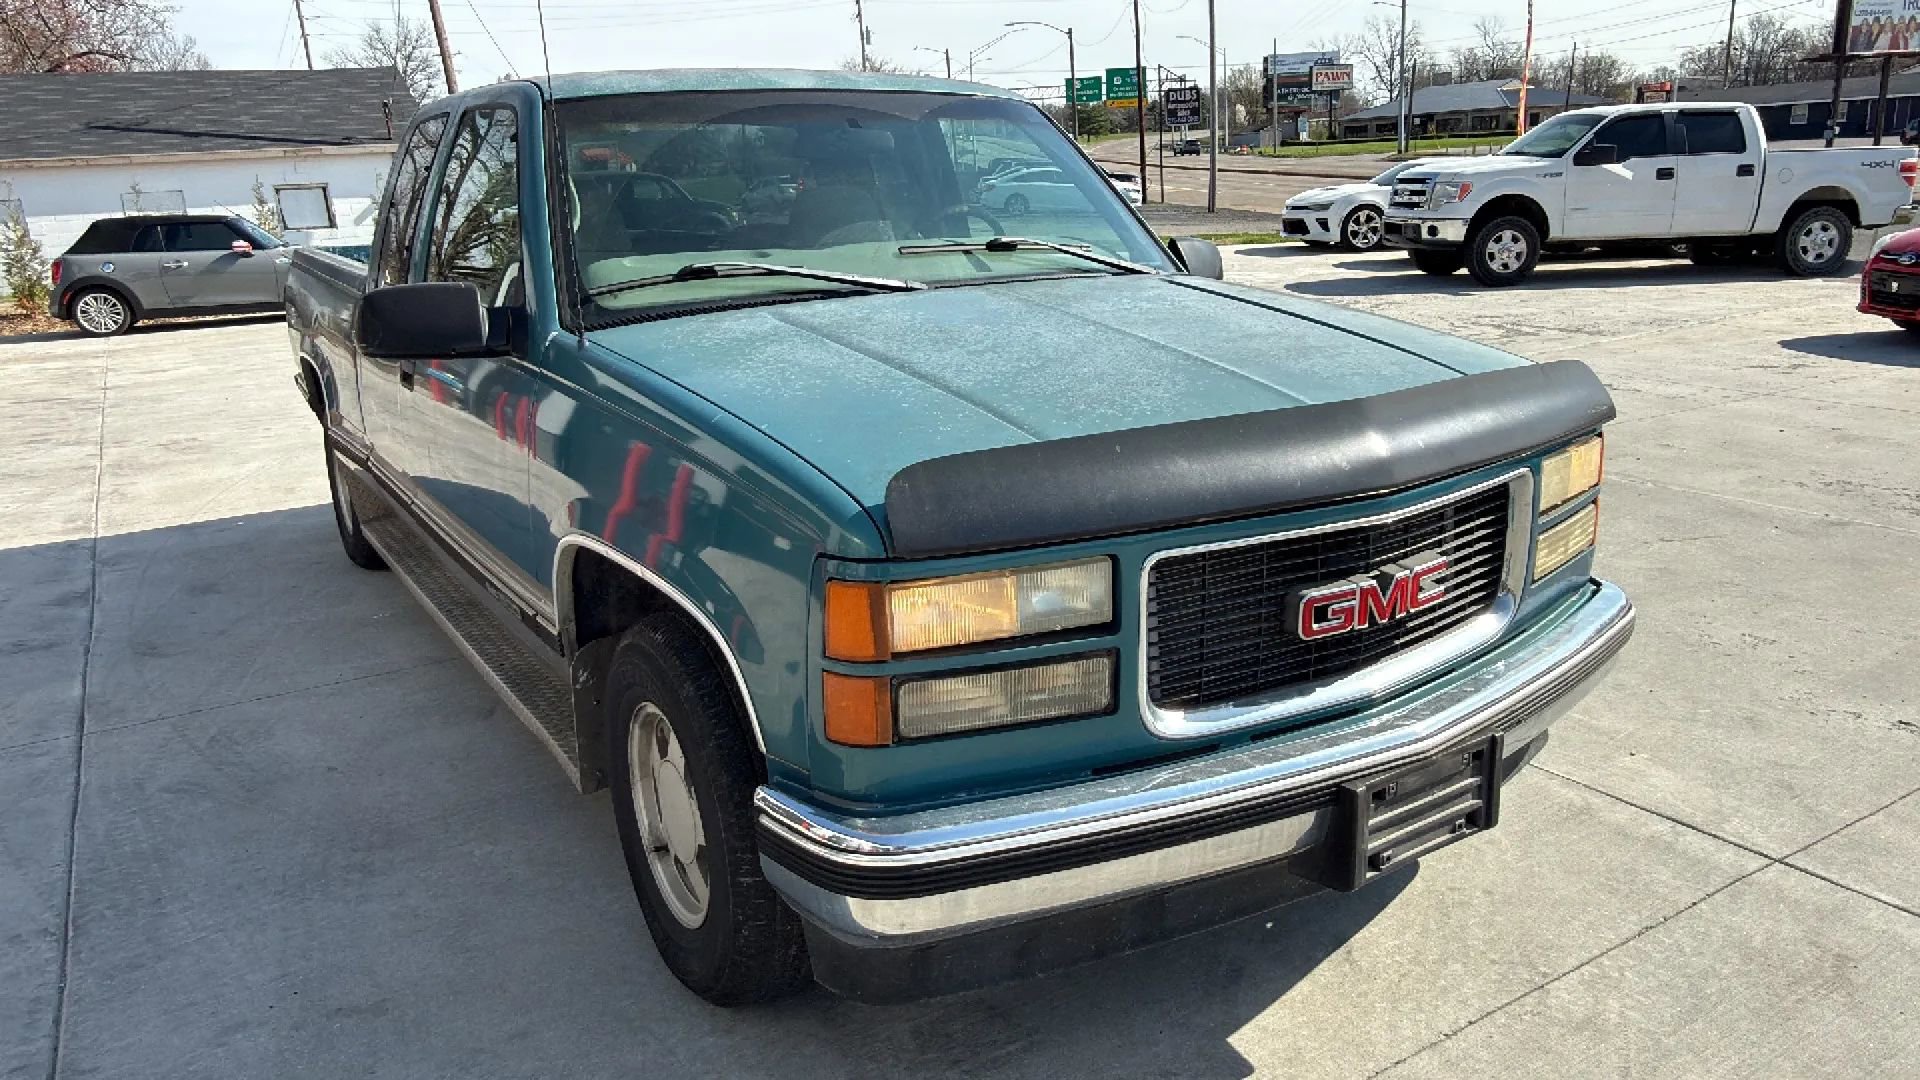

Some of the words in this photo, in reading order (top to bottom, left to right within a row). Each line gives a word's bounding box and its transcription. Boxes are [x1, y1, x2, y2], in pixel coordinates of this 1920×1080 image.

[1315, 71, 1351, 82] PAWN
[1169, 90, 1197, 101] DUBS
[1298, 556, 1449, 641] GMC
